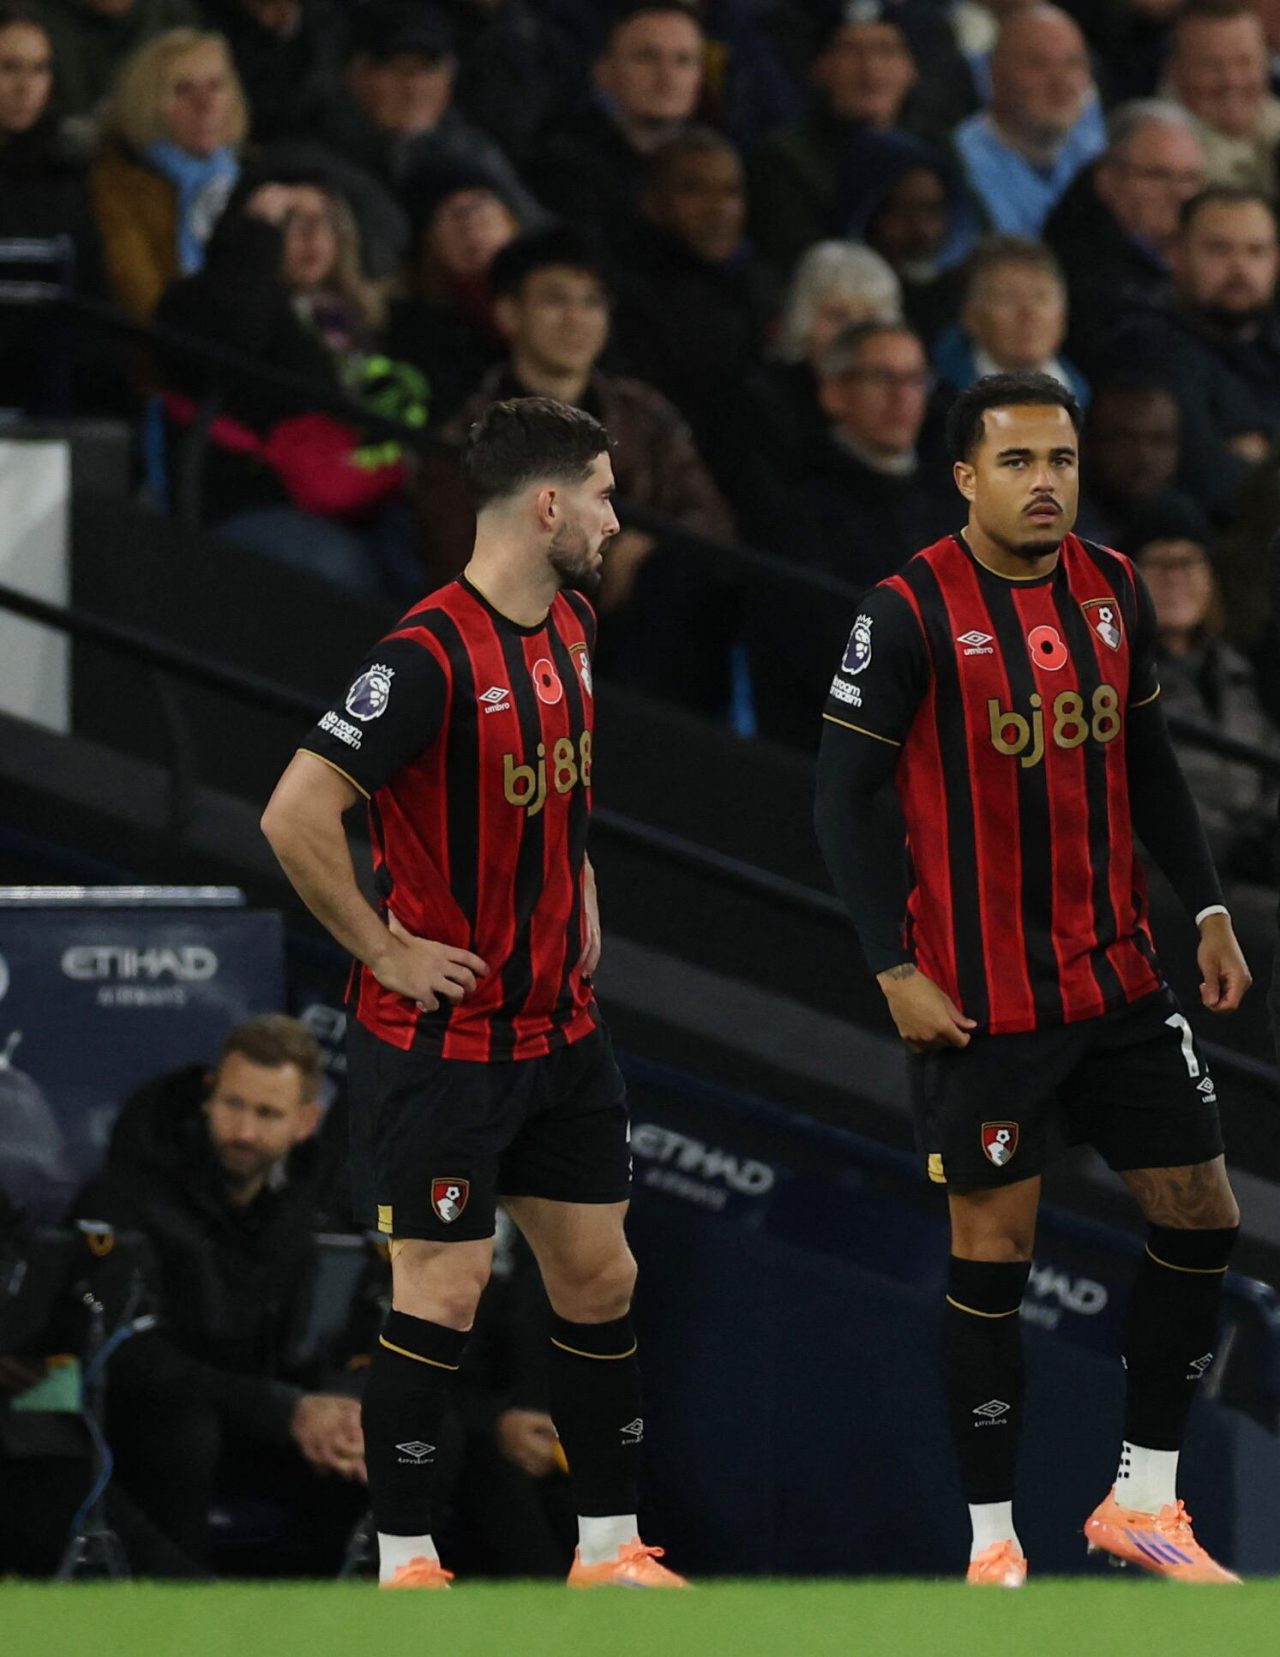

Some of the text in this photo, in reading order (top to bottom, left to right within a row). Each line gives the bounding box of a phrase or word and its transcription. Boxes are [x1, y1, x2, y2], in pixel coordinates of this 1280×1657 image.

[964, 646, 994, 656] umbro
[485, 702, 510, 714] umbro
[336, 719, 363, 740] room
[987, 684, 1122, 769] bj88
[504, 730, 592, 817] bj88
[61, 946, 218, 981] ETIHAD
[632, 1123, 774, 1195] ETIHAD
